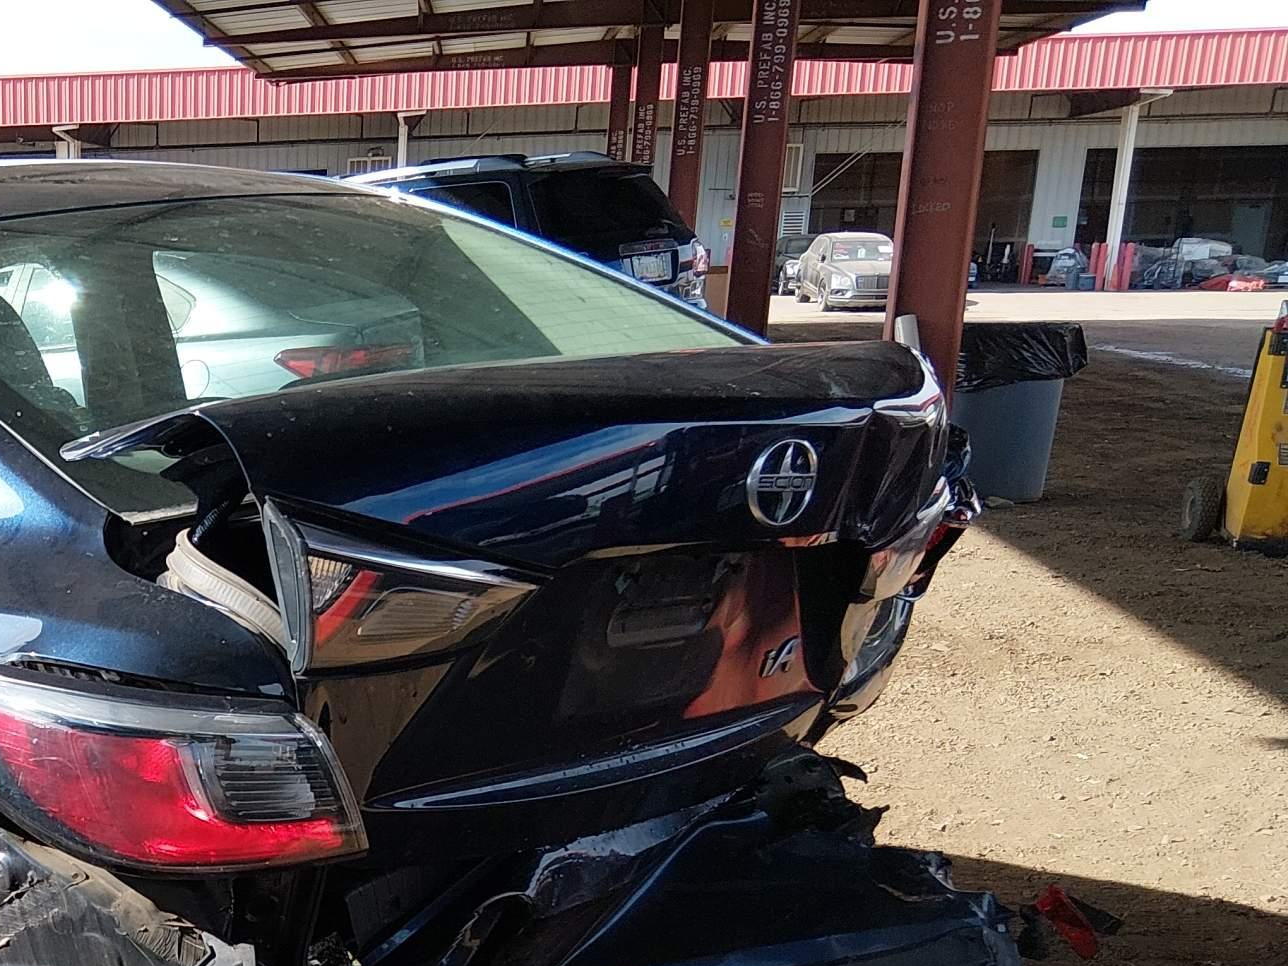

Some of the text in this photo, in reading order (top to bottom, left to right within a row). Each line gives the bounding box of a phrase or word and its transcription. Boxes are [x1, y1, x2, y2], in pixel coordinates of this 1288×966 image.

[959, 0, 982, 40] 1-8
[757, 32, 774, 88] PREFAB
[678, 91, 691, 132] PREFAB
[752, 96, 769, 124] U.S.
